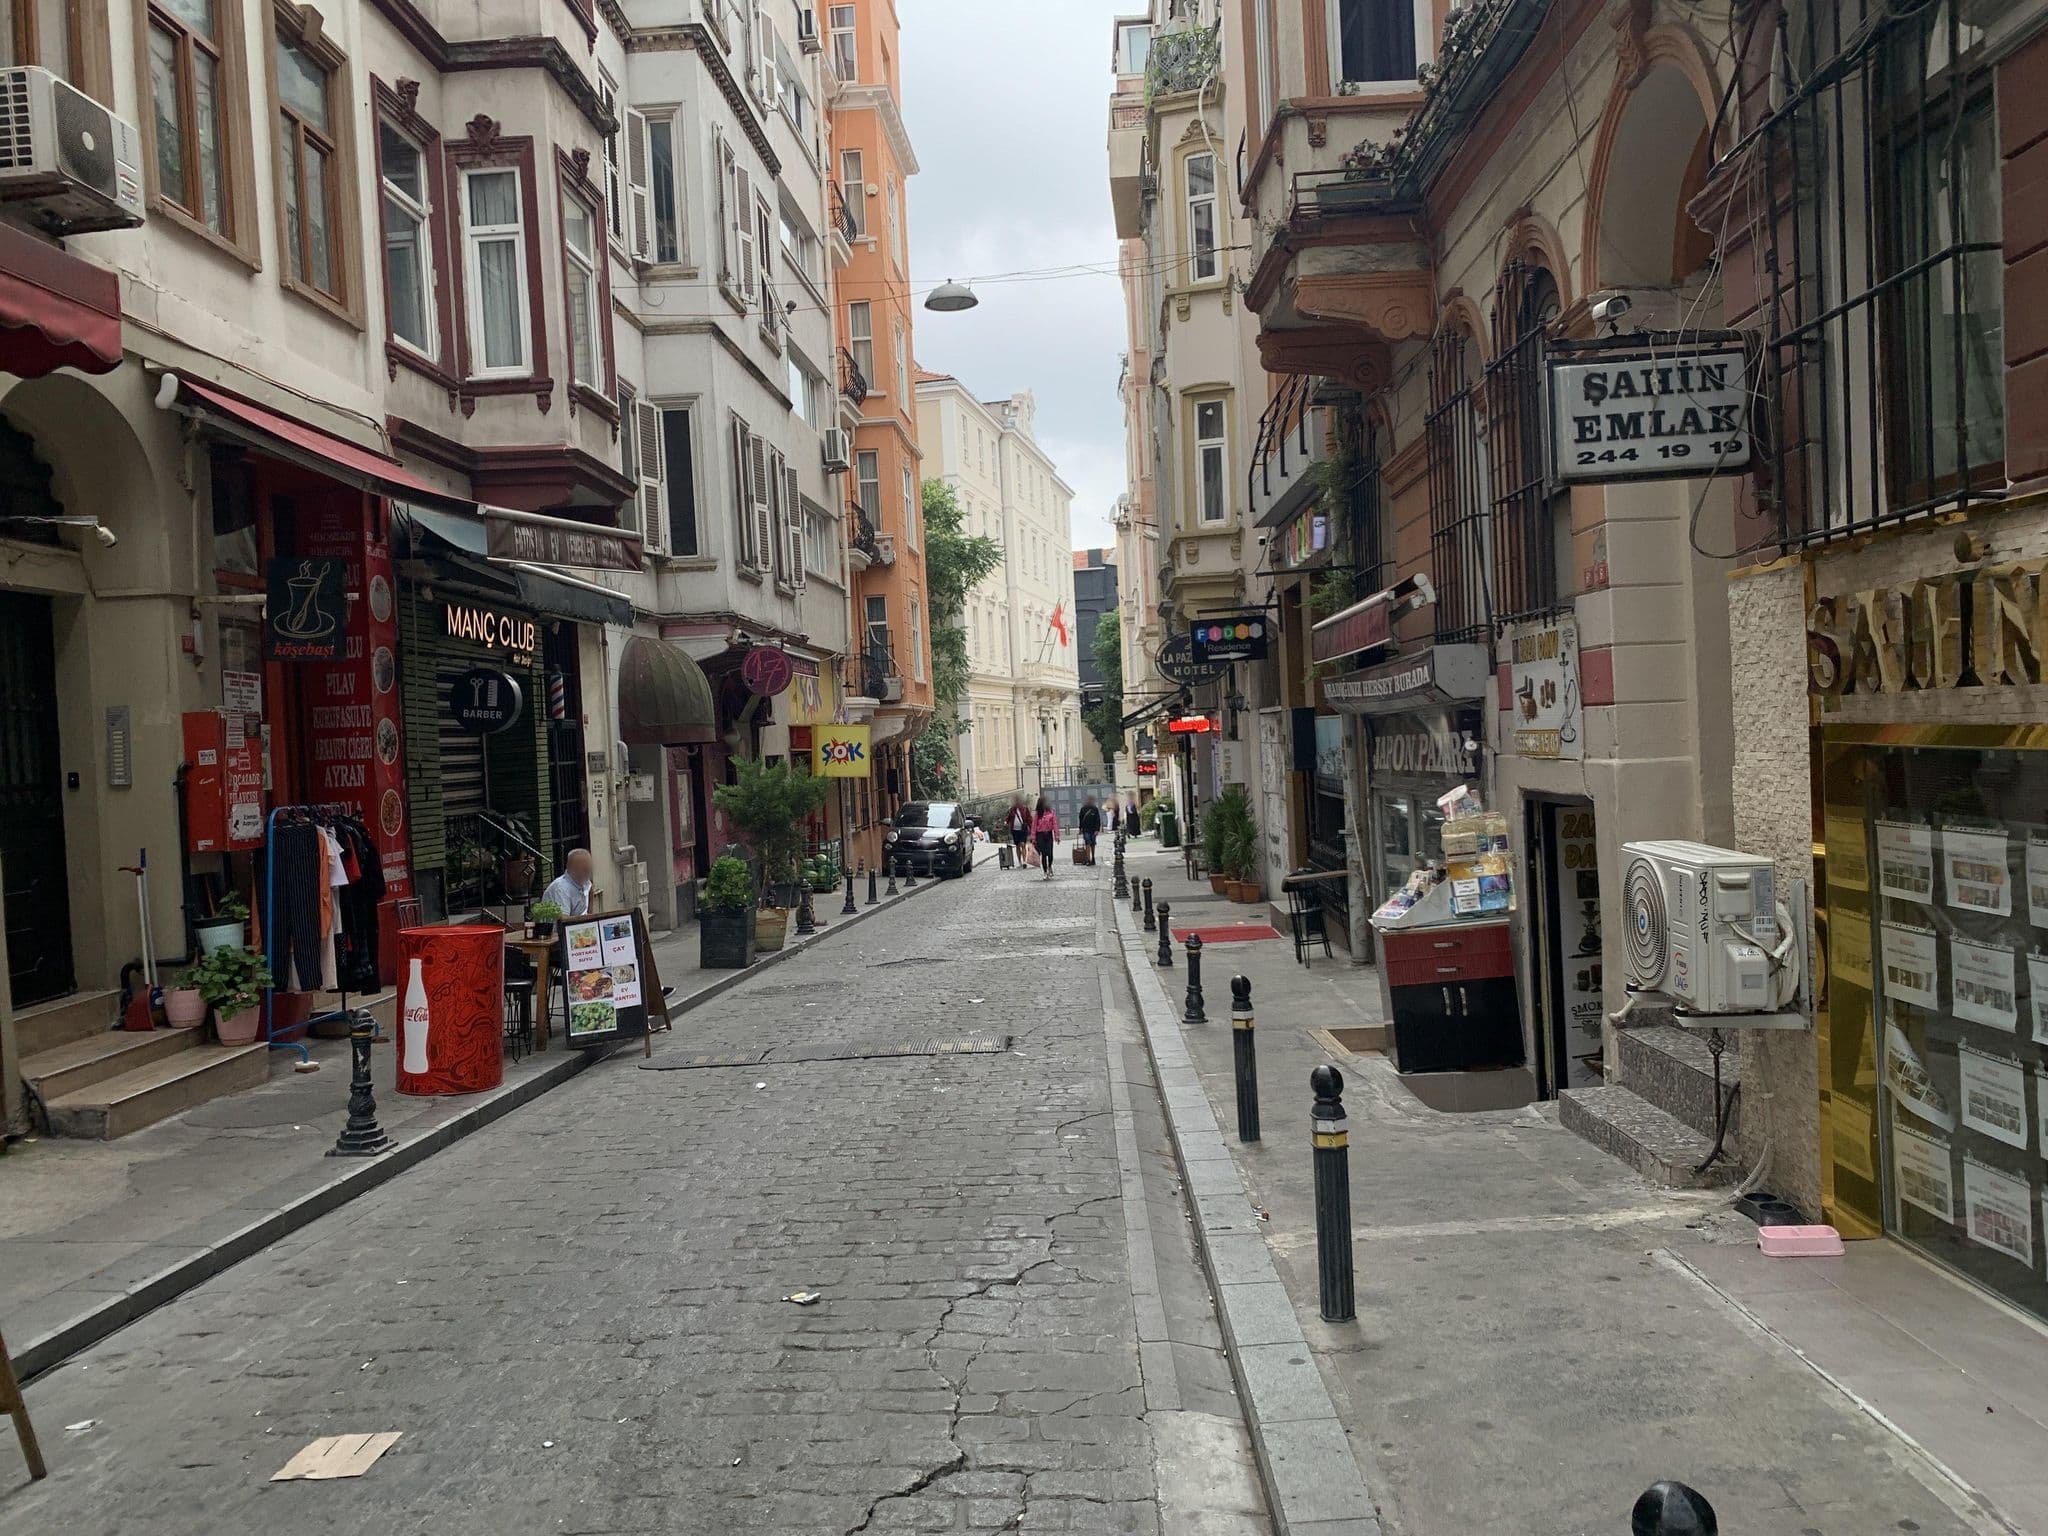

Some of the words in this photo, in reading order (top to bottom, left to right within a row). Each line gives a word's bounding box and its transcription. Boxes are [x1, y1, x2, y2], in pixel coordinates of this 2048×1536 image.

[1583, 361, 1728, 406] ŞAHİN
[1574, 404, 1739, 443] EMLAK
[1577, 448, 1639, 465] 244
[1657, 444, 1690, 458] 19
[1709, 440, 1743, 454] 19
[447, 603, 496, 649] MANÇ
[500, 616, 535, 651] CLUB
[1162, 651, 1174, 664] LA
[1174, 664, 1216, 676] HOTEL
[325, 668, 356, 696] PİLAV
[1394, 666, 1431, 693] BURADA
[463, 709, 503, 719] BARBER
[1373, 734, 1415, 772] JAPON
[324, 764, 366, 788] AYRAN
[612, 945, 625, 954] ÇAY
